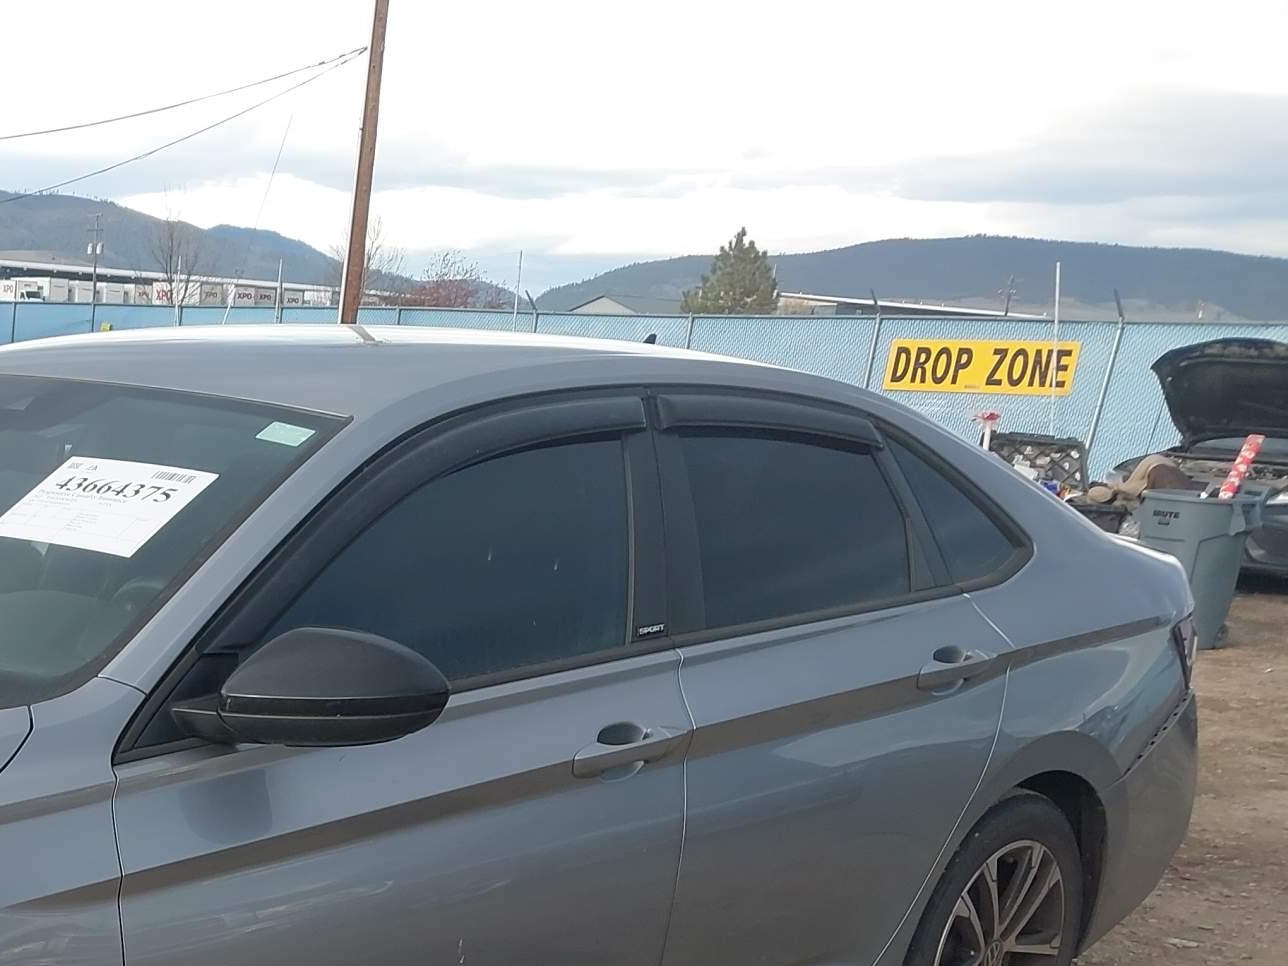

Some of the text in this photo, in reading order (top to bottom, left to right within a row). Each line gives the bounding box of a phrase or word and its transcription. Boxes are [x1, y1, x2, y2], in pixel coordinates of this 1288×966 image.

[237, 292, 253, 300] XPO
[890, 346, 1072, 388] DROP ZONE
[55, 475, 179, 503] 43664375
